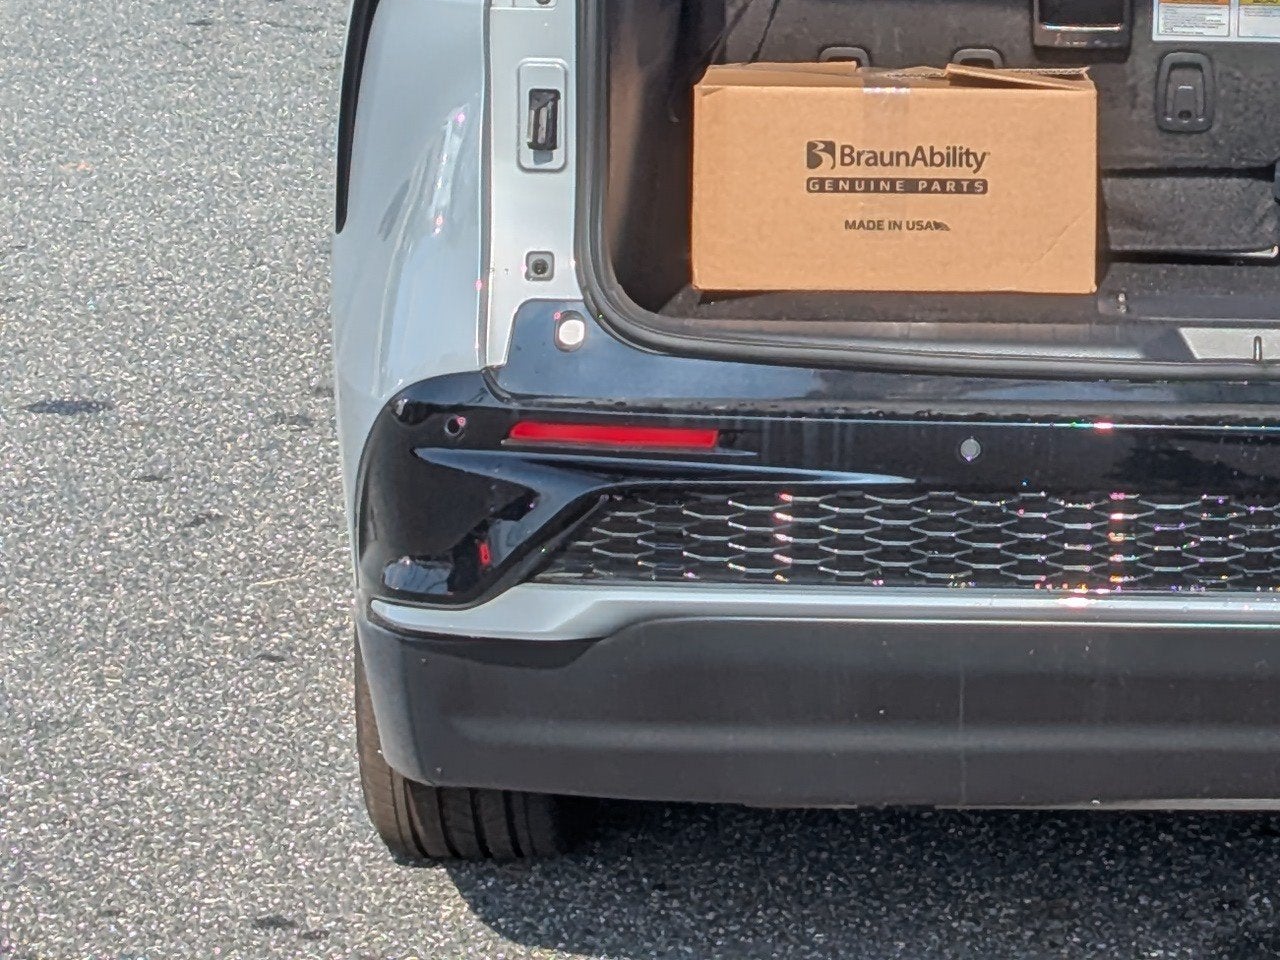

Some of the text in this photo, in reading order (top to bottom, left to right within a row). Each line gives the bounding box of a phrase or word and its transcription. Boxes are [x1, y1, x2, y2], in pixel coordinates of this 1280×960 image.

[840, 144, 987, 174] BraunAbility
[809, 179, 984, 193] GENUINE PARTS
[844, 219, 935, 231] MADE IN USA
